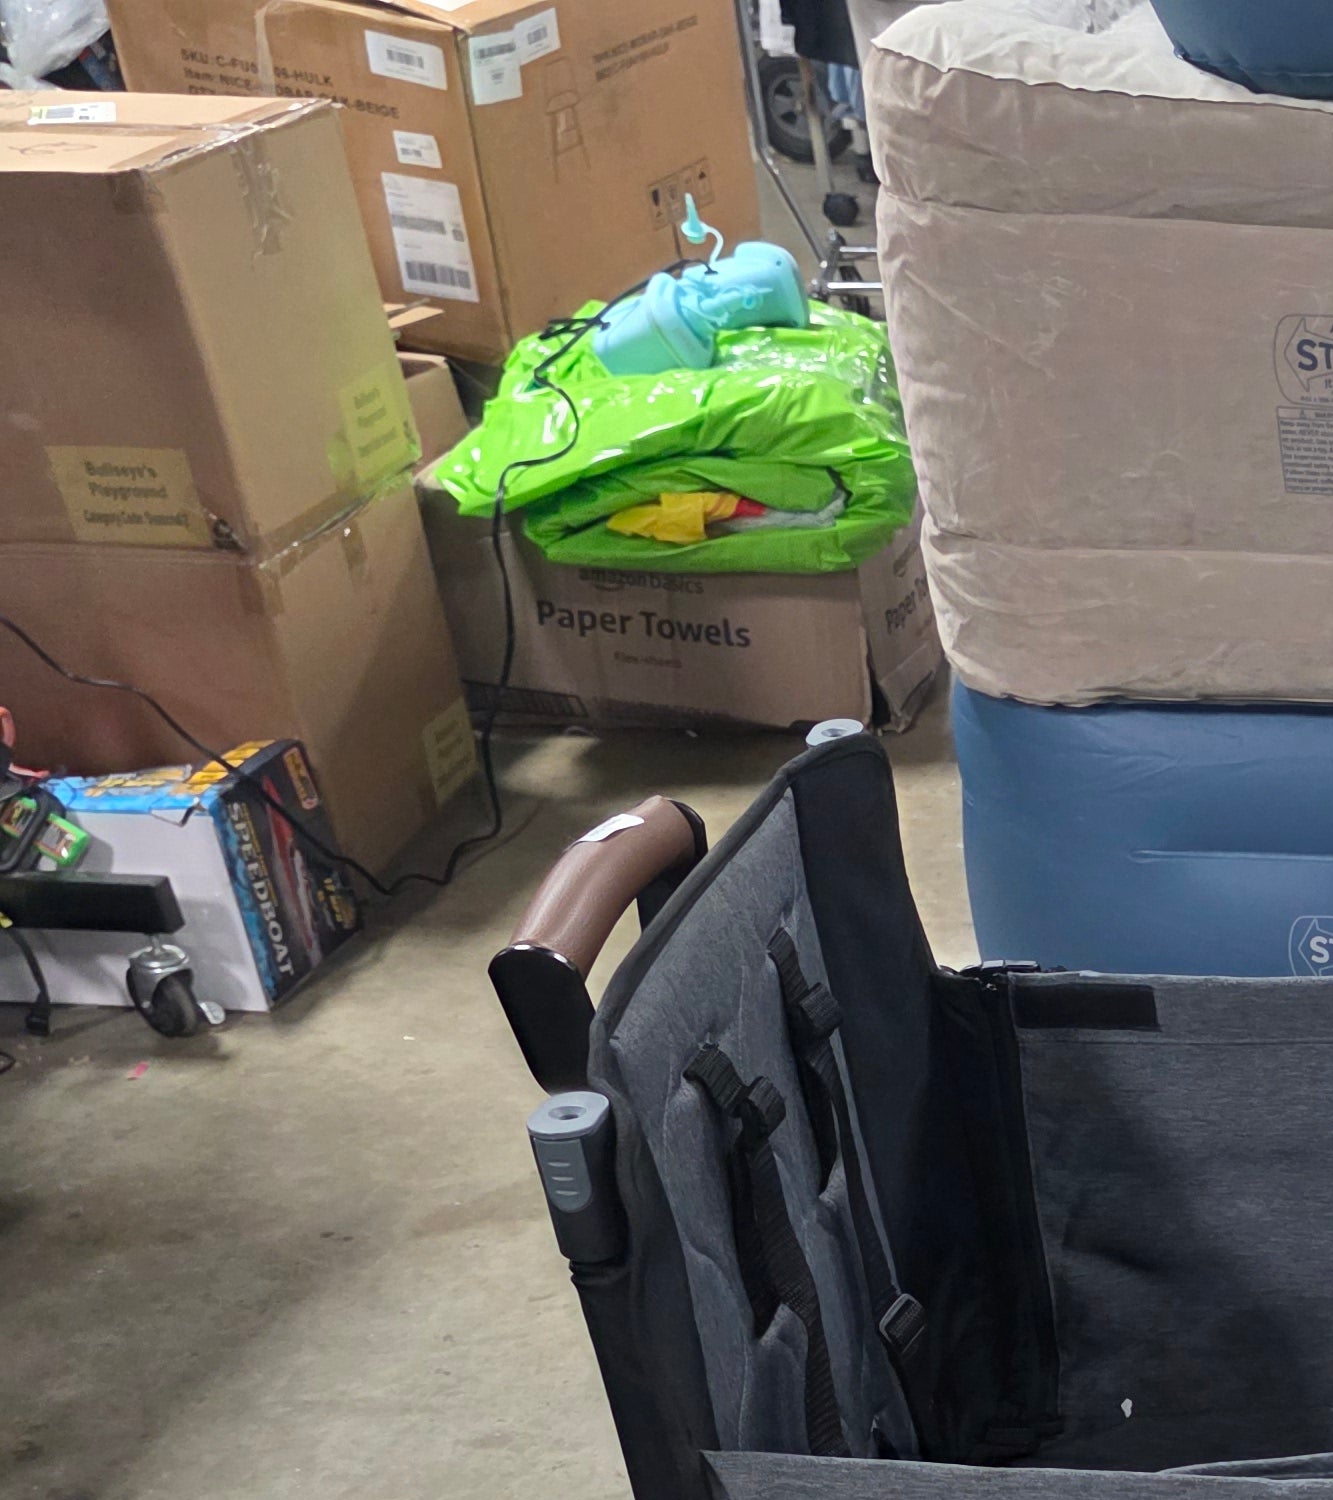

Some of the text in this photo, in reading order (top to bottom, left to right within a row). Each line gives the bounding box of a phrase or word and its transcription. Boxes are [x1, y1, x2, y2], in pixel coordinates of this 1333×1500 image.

[536, 600, 752, 649] Paper Towels
[228, 802, 294, 976] SPEEDBOAT
